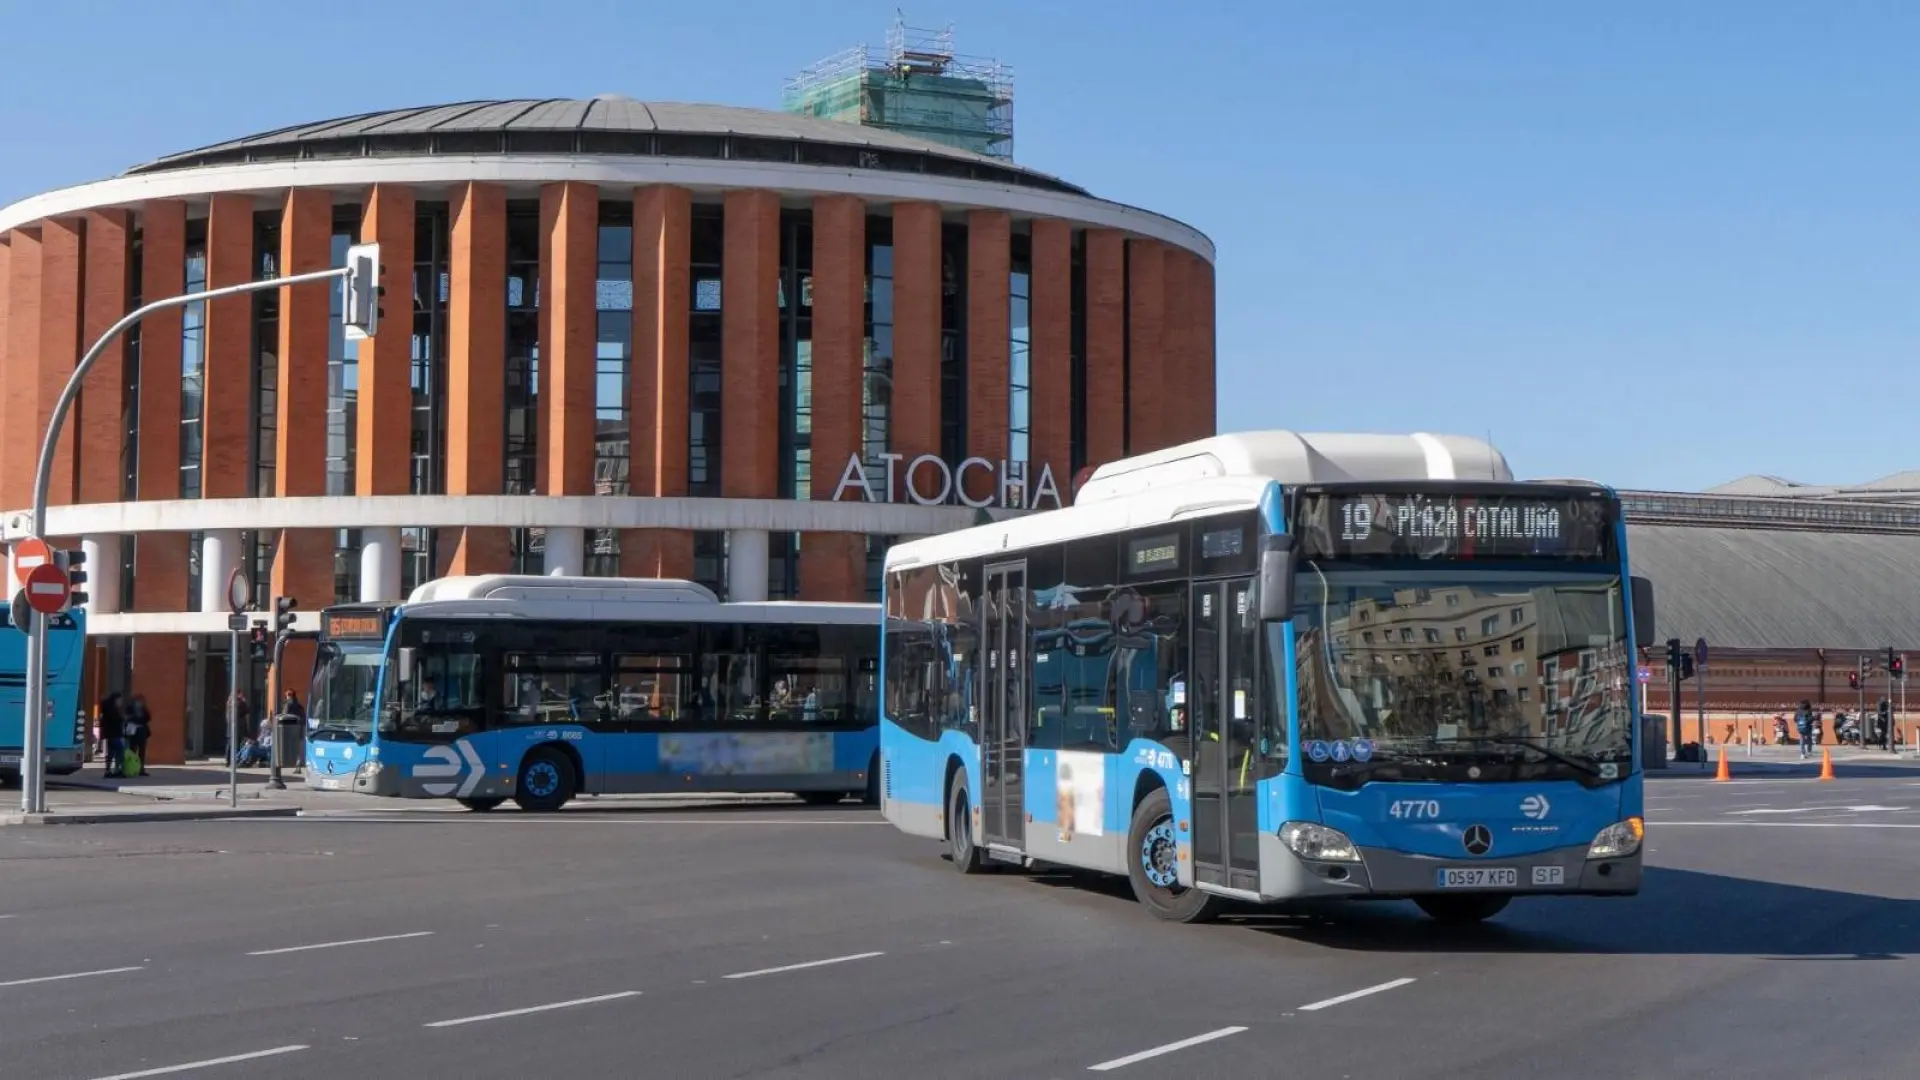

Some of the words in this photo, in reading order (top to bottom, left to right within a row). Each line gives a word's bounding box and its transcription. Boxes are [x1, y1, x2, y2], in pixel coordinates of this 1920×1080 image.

[833, 452, 1062, 509] ATOCHA
[1341, 503, 1372, 540] 19
[1398, 505, 1458, 537] PLAZA
[1389, 800, 1440, 819] 4770
[1448, 870, 1484, 885] 0597
[1488, 869, 1516, 885] KFD
[1535, 868, 1561, 883] SP
